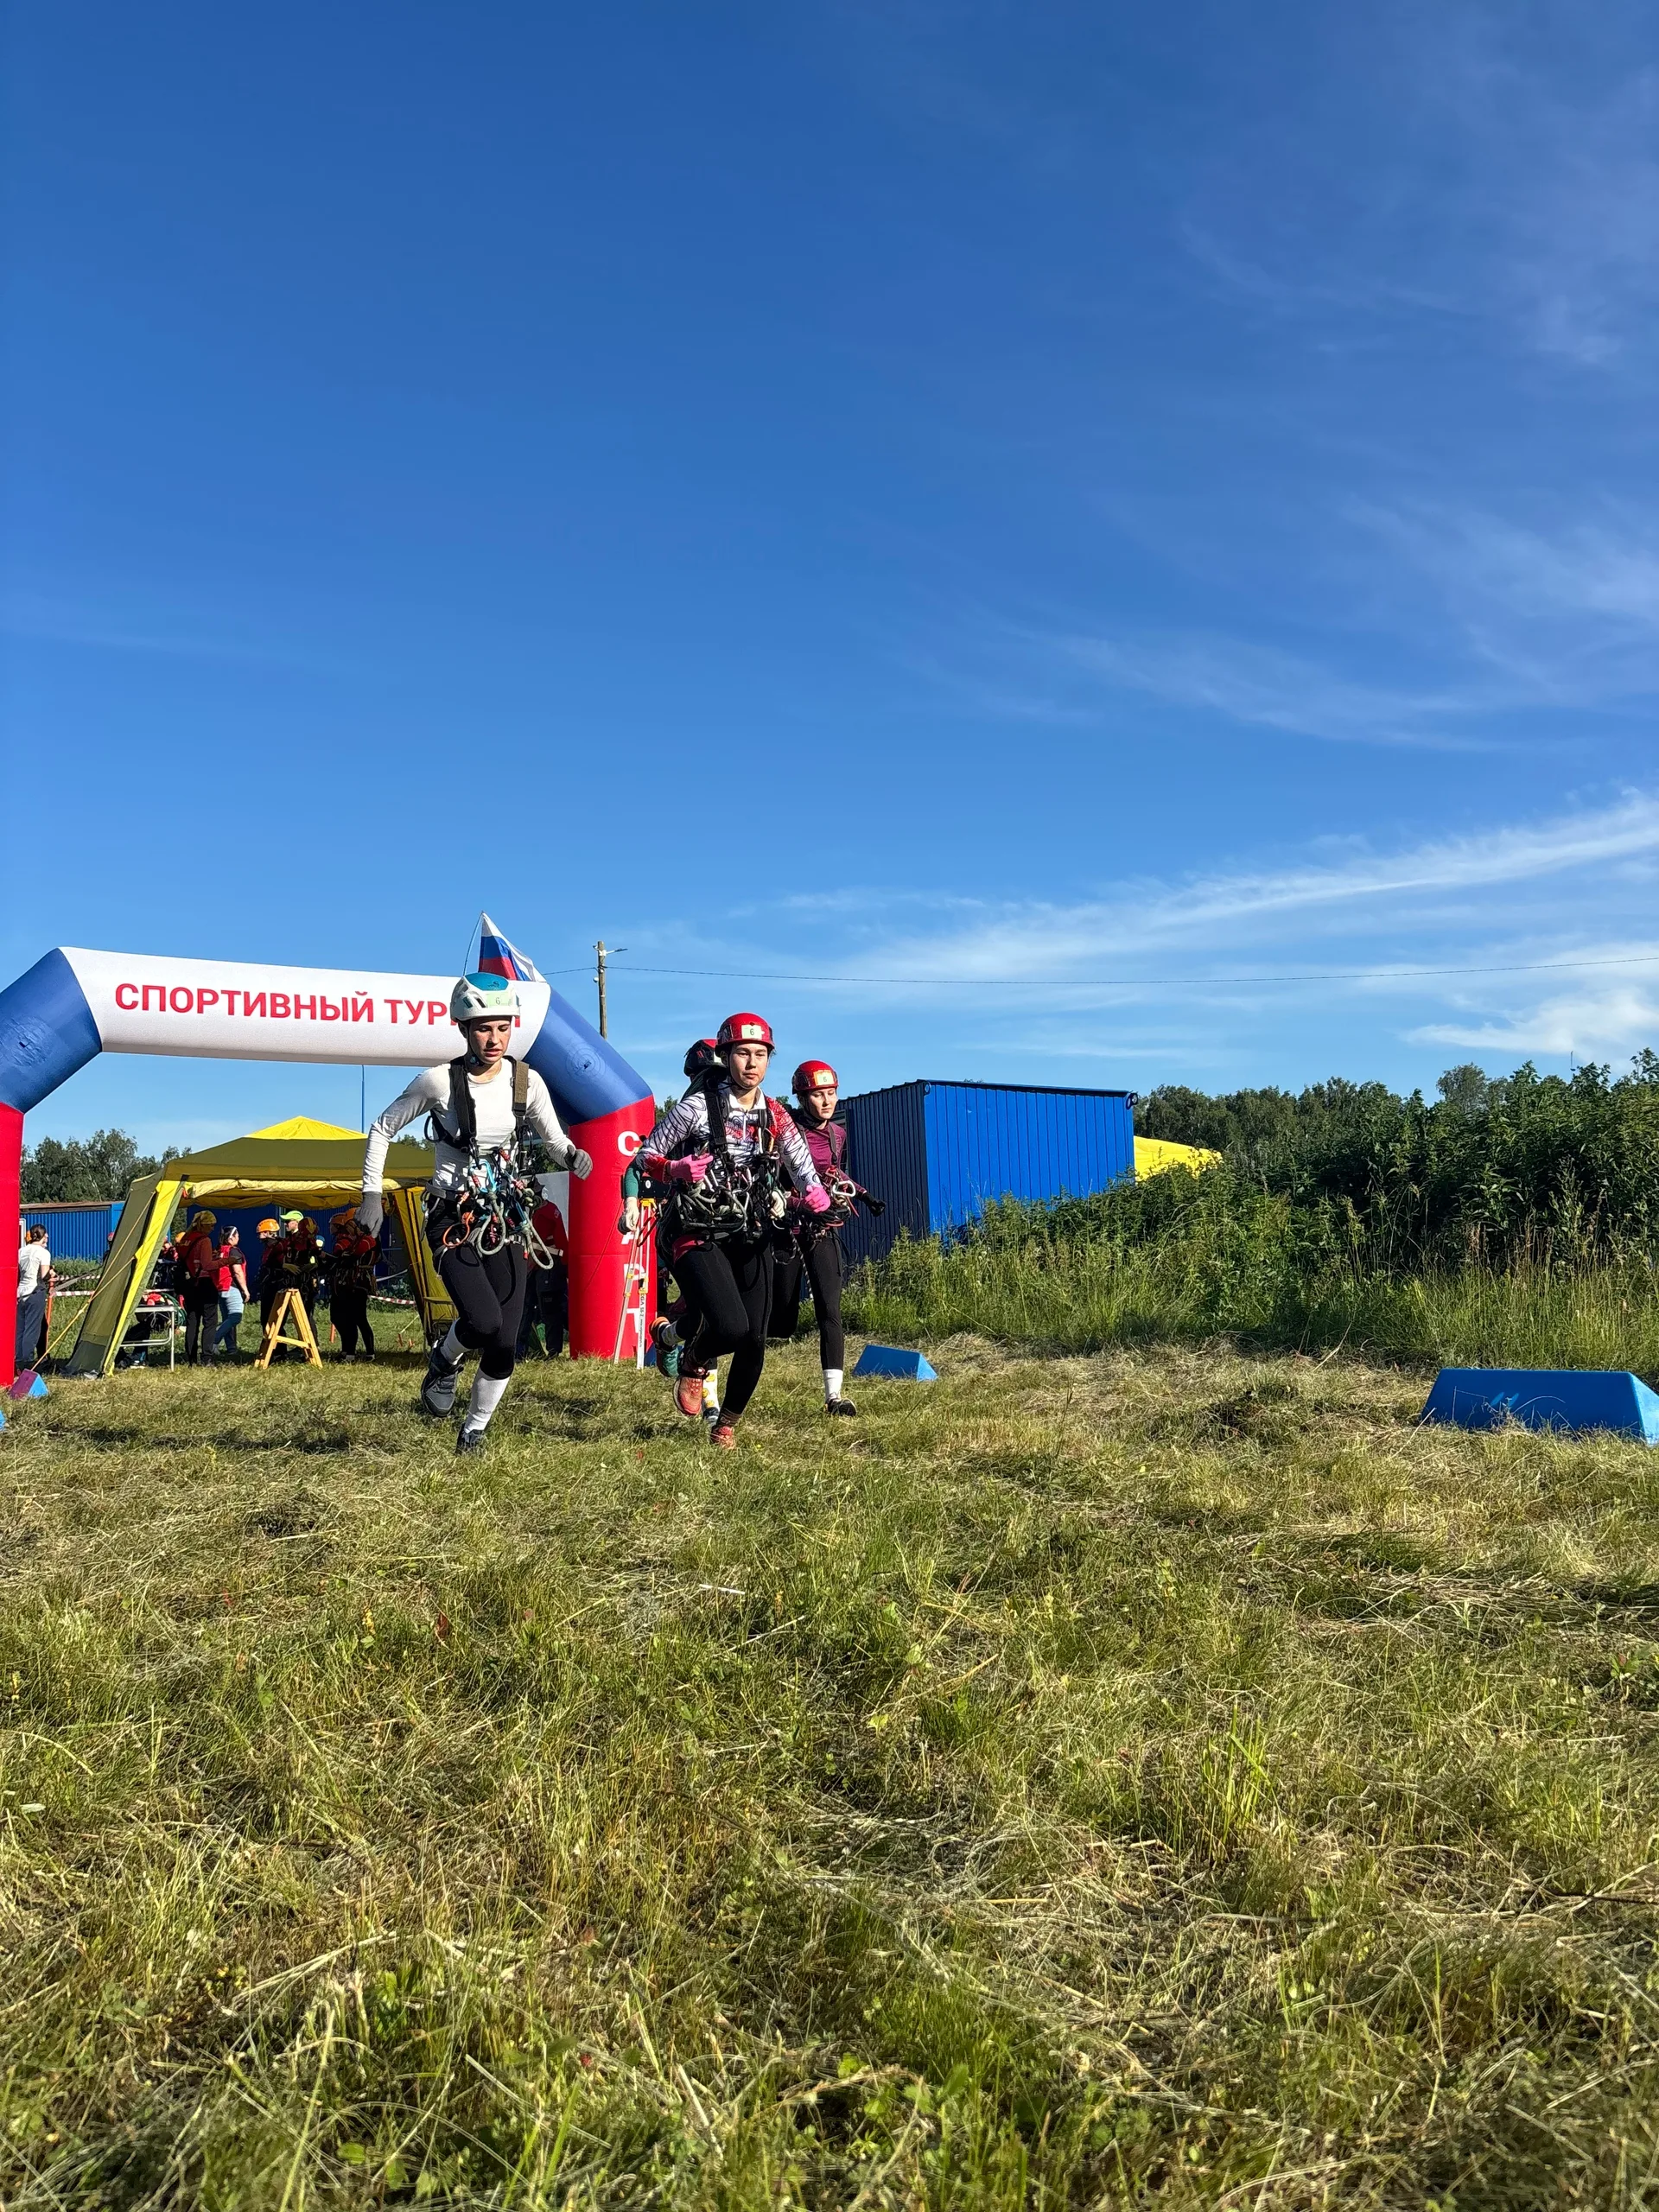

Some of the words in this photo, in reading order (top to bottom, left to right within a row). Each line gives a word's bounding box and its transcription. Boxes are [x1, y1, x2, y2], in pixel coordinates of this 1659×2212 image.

[115, 983, 374, 1023] СПОРТИВНЫЙ
[384, 999, 521, 1028] ТУР
[495, 996, 501, 1006] 6
[749, 1027, 755, 1036] 6
